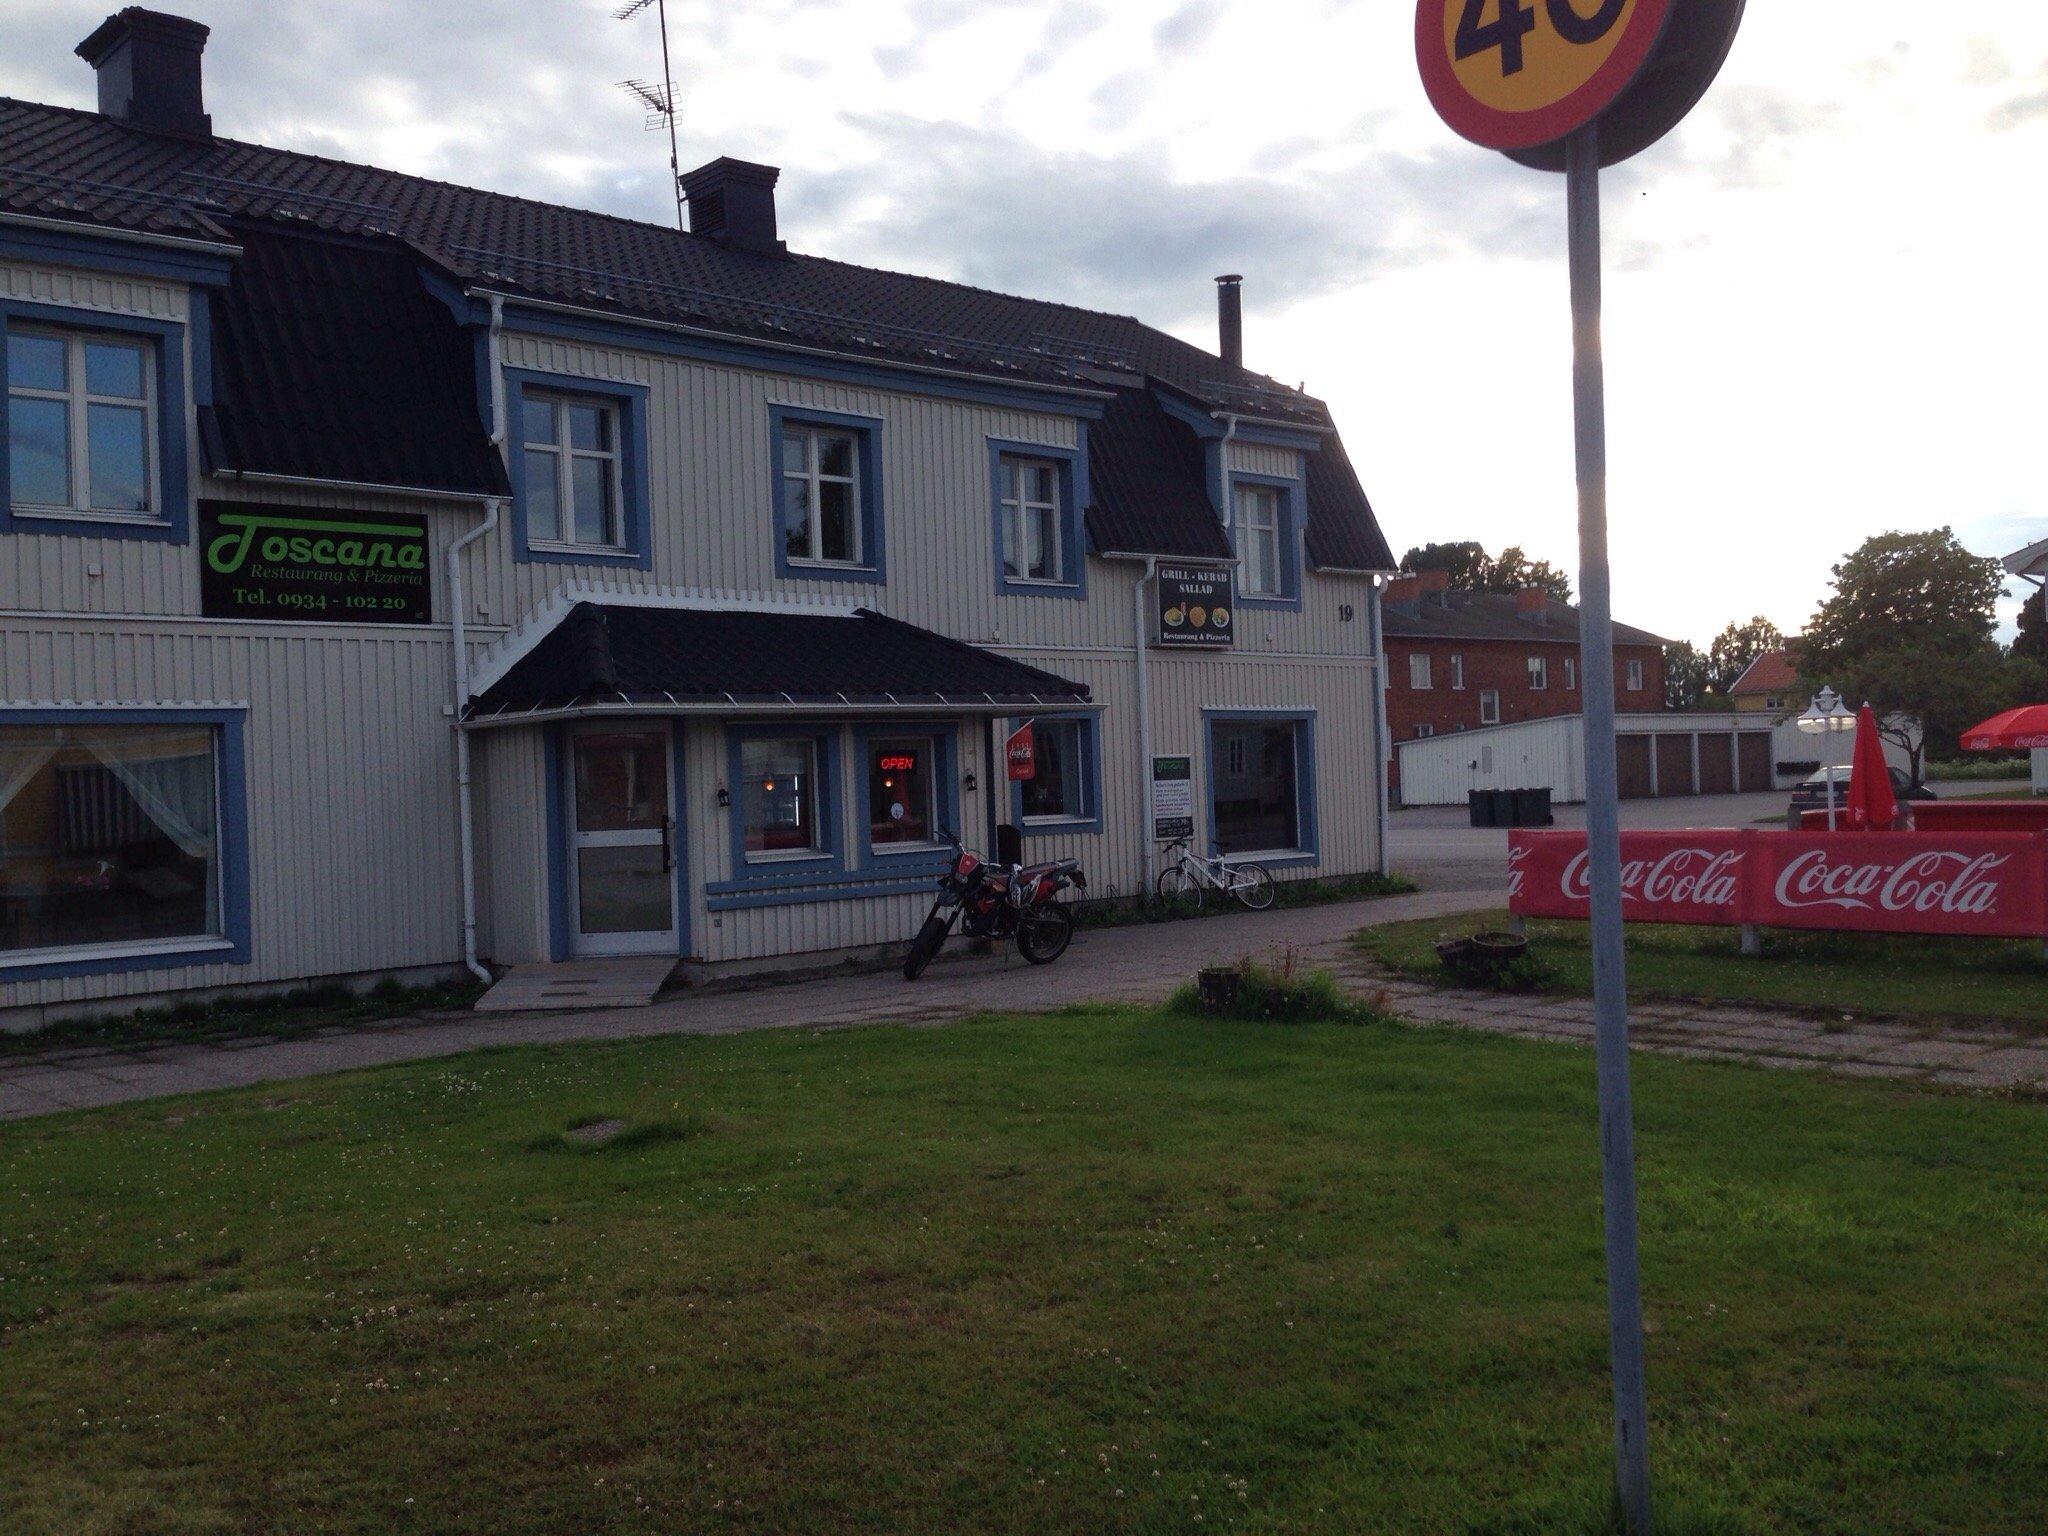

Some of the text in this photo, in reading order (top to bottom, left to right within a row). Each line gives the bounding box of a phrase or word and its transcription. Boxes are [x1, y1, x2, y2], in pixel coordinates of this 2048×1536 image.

[207, 514, 425, 573] Toscana
[251, 564, 424, 585] Restaurang & Pizzeria
[1197, 571, 1227, 582] KEBAB
[232, 589, 271, 605] Tel.
[277, 593, 328, 610] 0934
[382, 597, 406, 610] 20
[1179, 584, 1213, 594] SALLAD
[1339, 604, 1352, 622] 19
[881, 758, 913, 769] OPEN
[1561, 848, 1747, 905] Coa-Cola
[1775, 849, 2012, 914] Coca-Cola
